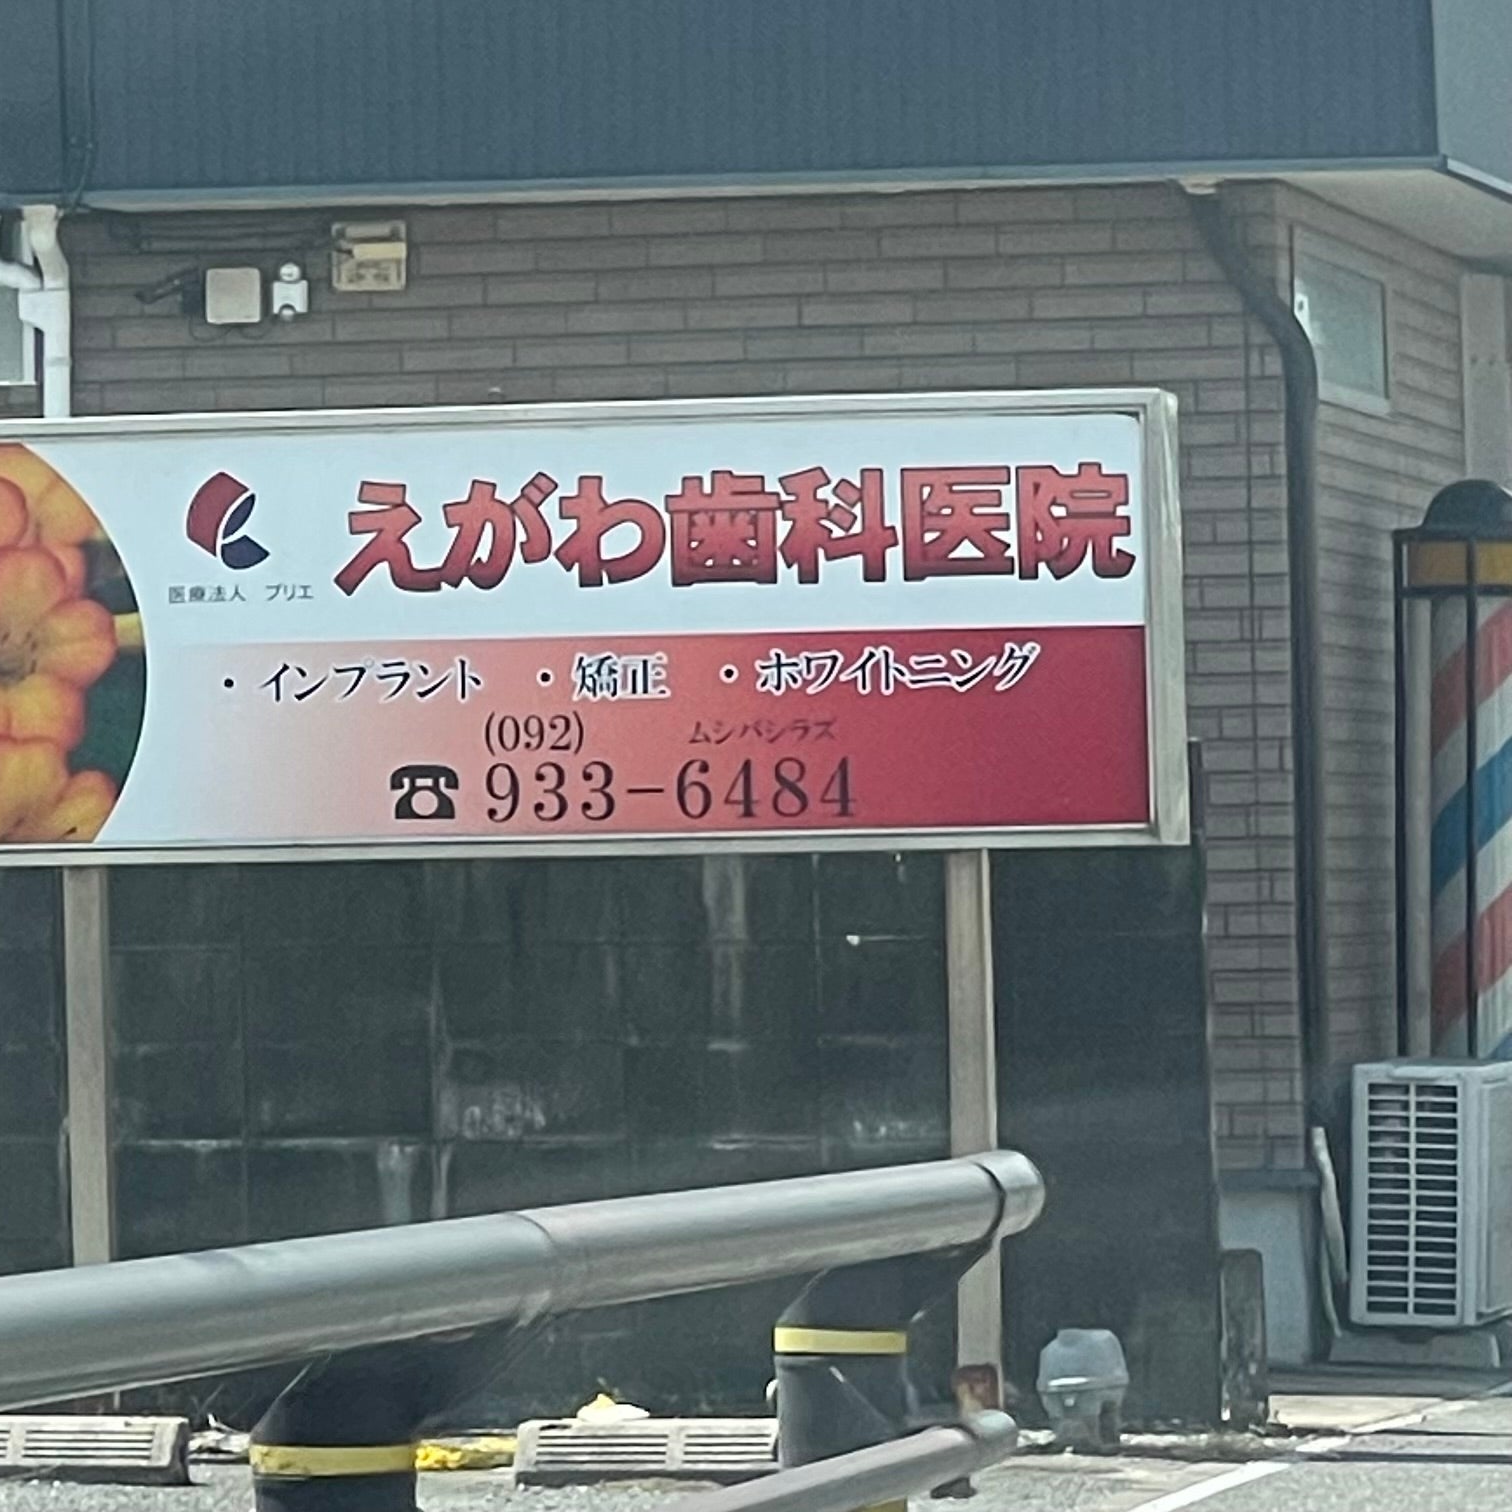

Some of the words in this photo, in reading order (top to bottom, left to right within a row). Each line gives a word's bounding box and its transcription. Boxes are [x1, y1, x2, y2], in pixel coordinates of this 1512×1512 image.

[334, 462, 1136, 596] えがわ歯科医院
[168, 584, 247, 604] 医療法人
[484, 710, 584, 755] (092)
[486, 756, 857, 824] 933-6484
